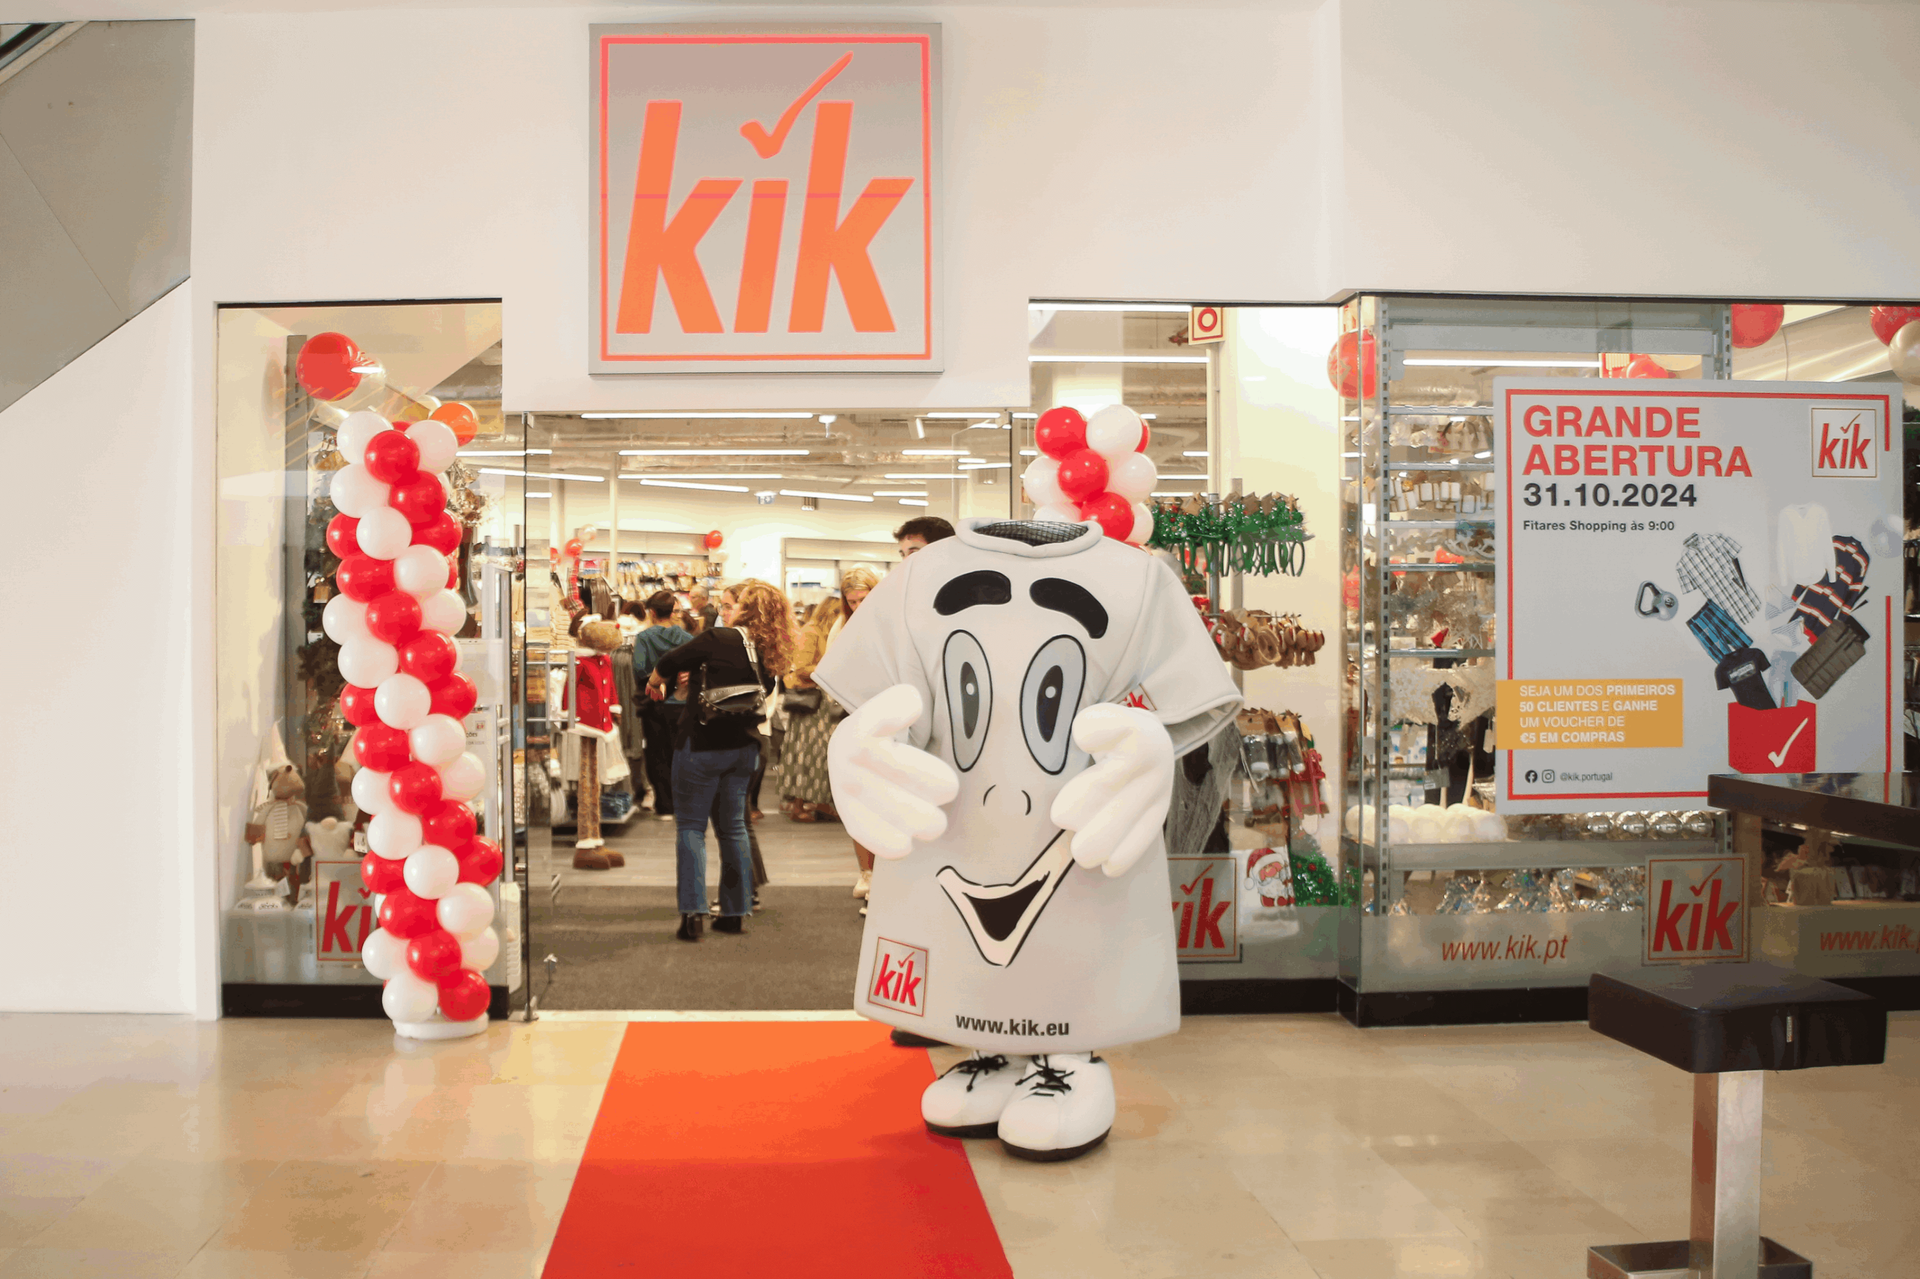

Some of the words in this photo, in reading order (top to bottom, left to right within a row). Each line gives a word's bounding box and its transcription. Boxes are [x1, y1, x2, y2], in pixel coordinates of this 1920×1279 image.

[615, 51, 915, 334] kik
[1523, 405, 1700, 438] GRANDE
[1818, 413, 1871, 469] kik
[1522, 444, 1753, 477] ABERTURA
[1523, 482, 1697, 507] 31.10.2024
[1523, 520, 1565, 531] Fitares
[1569, 520, 1626, 532] Shopping
[1630, 520, 1644, 531] às
[1648, 520, 1675, 531] 9:00
[1519, 685, 1551, 697] SEJA
[1553, 685, 1573, 696] UM
[1576, 685, 1603, 696] DOS
[1606, 684, 1676, 696] PRIMEIROS
[1519, 701, 1534, 712] 50
[1537, 700, 1599, 712] CLIENTES
[1602, 700, 1609, 711] E
[1613, 700, 1658, 711] GANHE
[1519, 717, 1540, 728] UM
[1543, 716, 1605, 727] VOUCHER
[1608, 715, 1625, 727] DE
[1520, 732, 1536, 743] €5
[1540, 732, 1558, 743] EM
[1561, 731, 1625, 743] COMPRAS
[1560, 771, 1613, 782] @kik.portugal
[321, 881, 381, 953] ki
[1653, 864, 1739, 951] kik
[1442, 934, 1568, 964] www.kik.pt
[873, 952, 922, 1007] kik
[955, 1014, 1070, 1036] www.kik.eu
